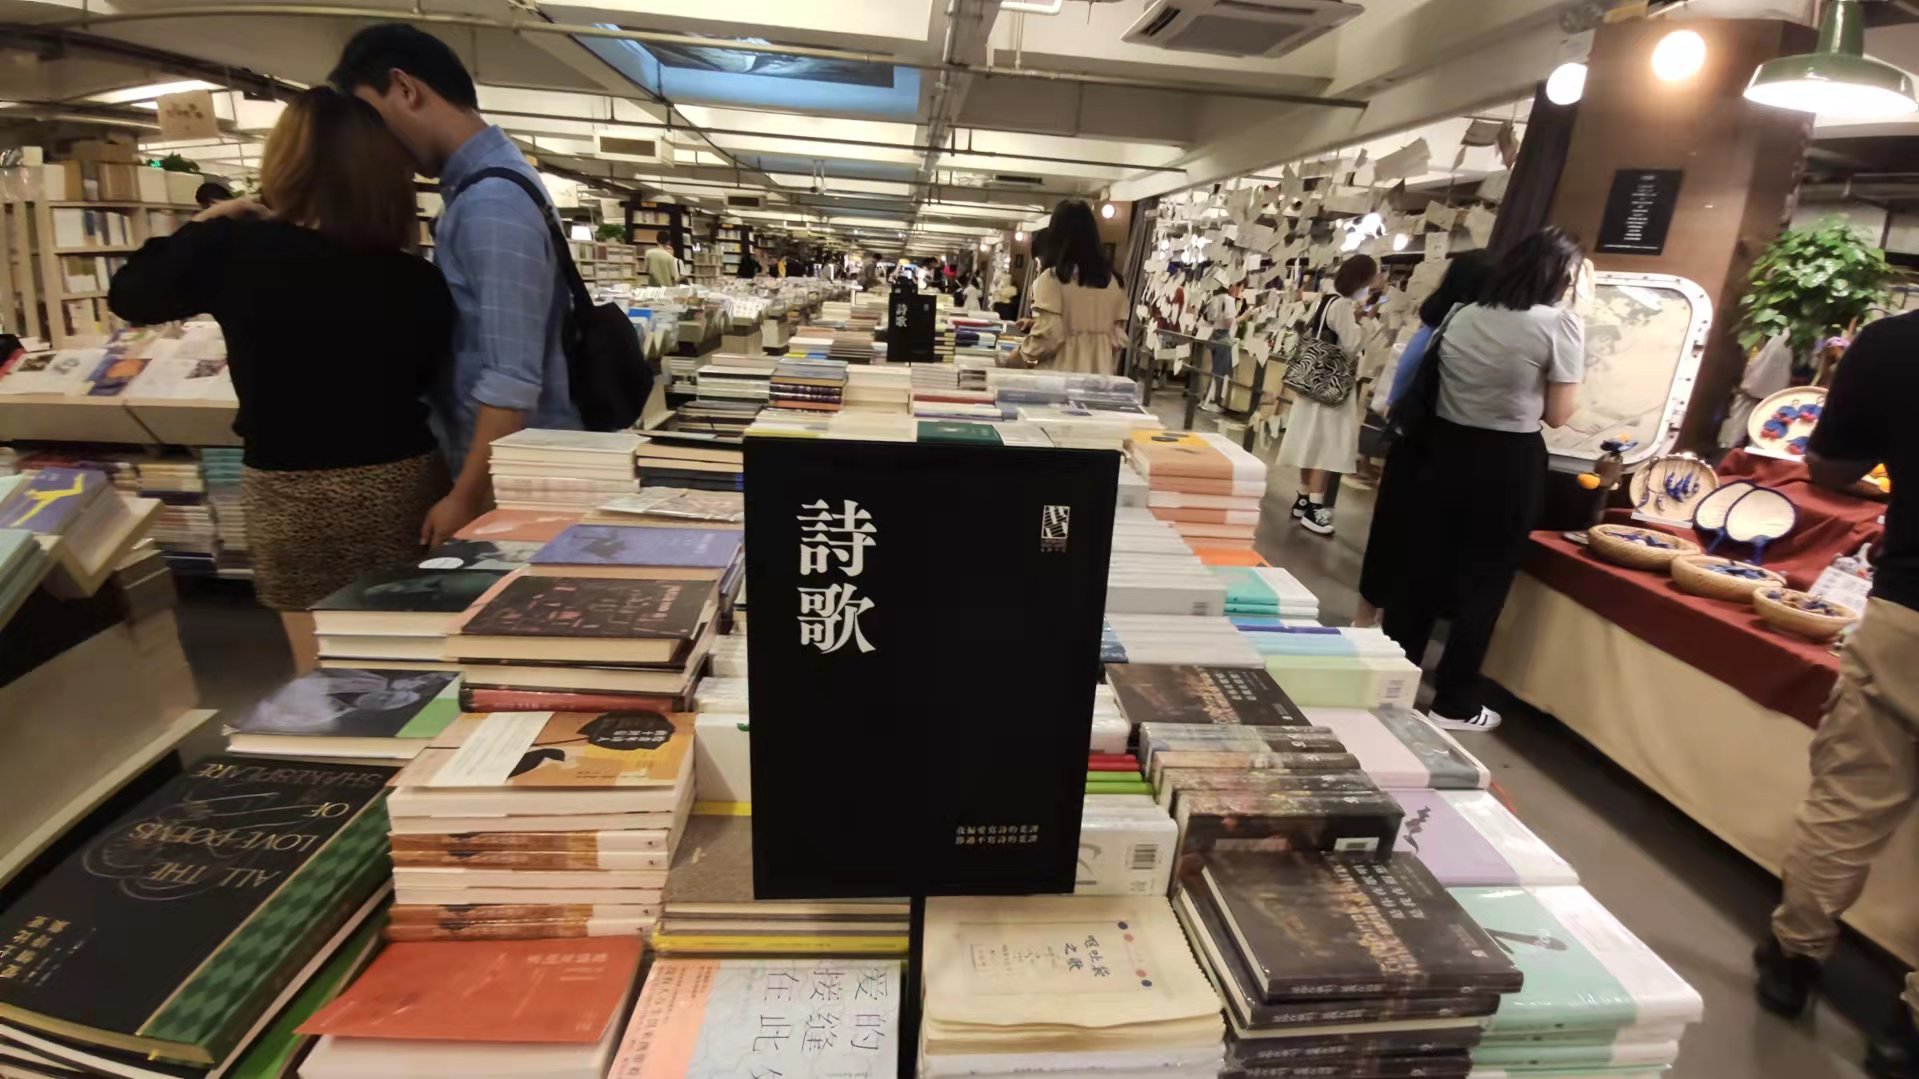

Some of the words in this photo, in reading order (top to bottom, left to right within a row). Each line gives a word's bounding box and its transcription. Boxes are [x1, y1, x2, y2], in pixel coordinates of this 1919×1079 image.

[796, 498, 877, 654] 詩歌
[189, 763, 384, 788] SHAKESPEARE
[302, 802, 349, 818] OF
[129, 821, 235, 847] POEMS
[242, 831, 319, 852] LOVE
[146, 861, 207, 884] THE
[216, 867, 281, 887] ALL
[1064, 943, 1084, 973] 之歌
[801, 968, 844, 1053] 接缝
[850, 966, 889, 1052] 爱的
